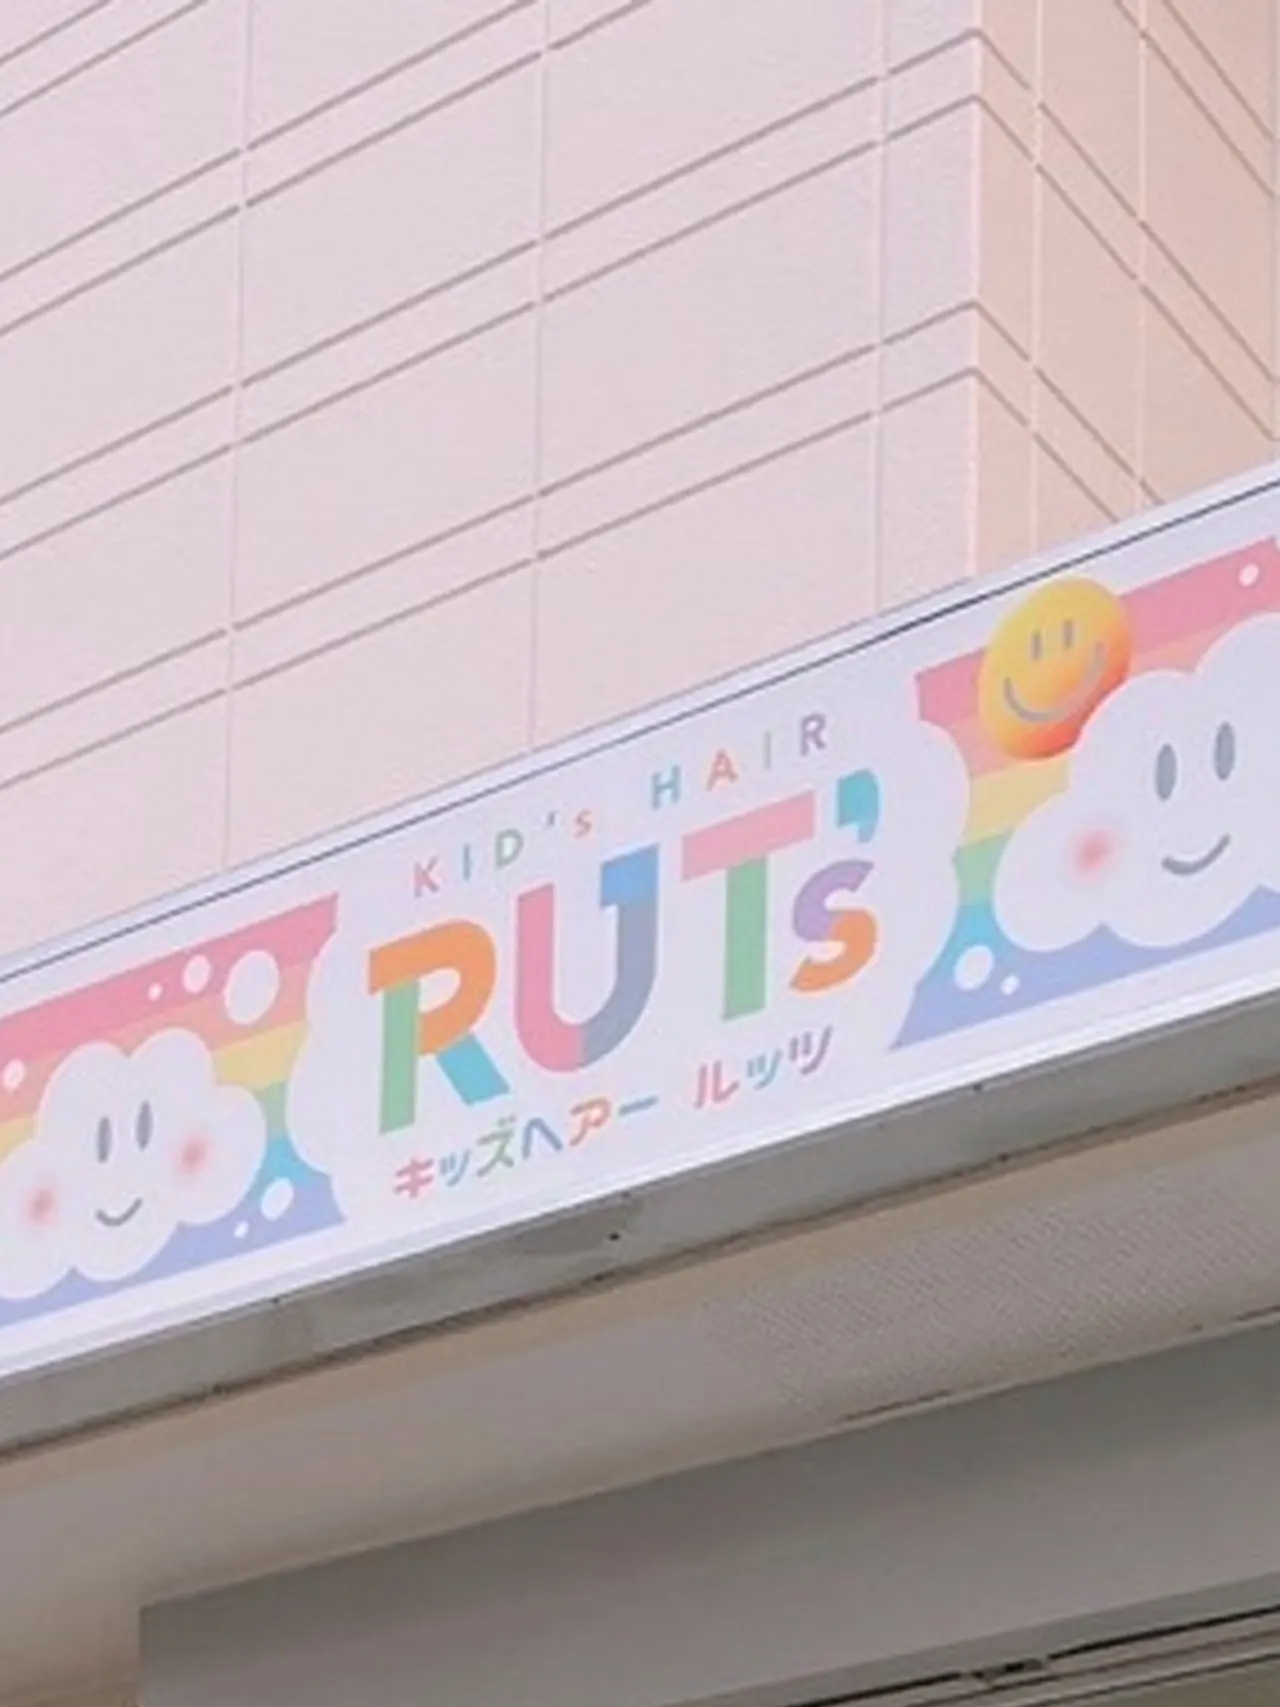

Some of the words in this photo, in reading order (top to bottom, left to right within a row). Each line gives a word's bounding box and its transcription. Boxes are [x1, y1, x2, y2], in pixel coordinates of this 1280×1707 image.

[412, 809, 595, 899] KID's
[649, 712, 829, 809] HAIR
[368, 768, 881, 1136] RUT's
[393, 1096, 660, 1198] キッズヘアー
[693, 1024, 833, 1110] ルッツ
